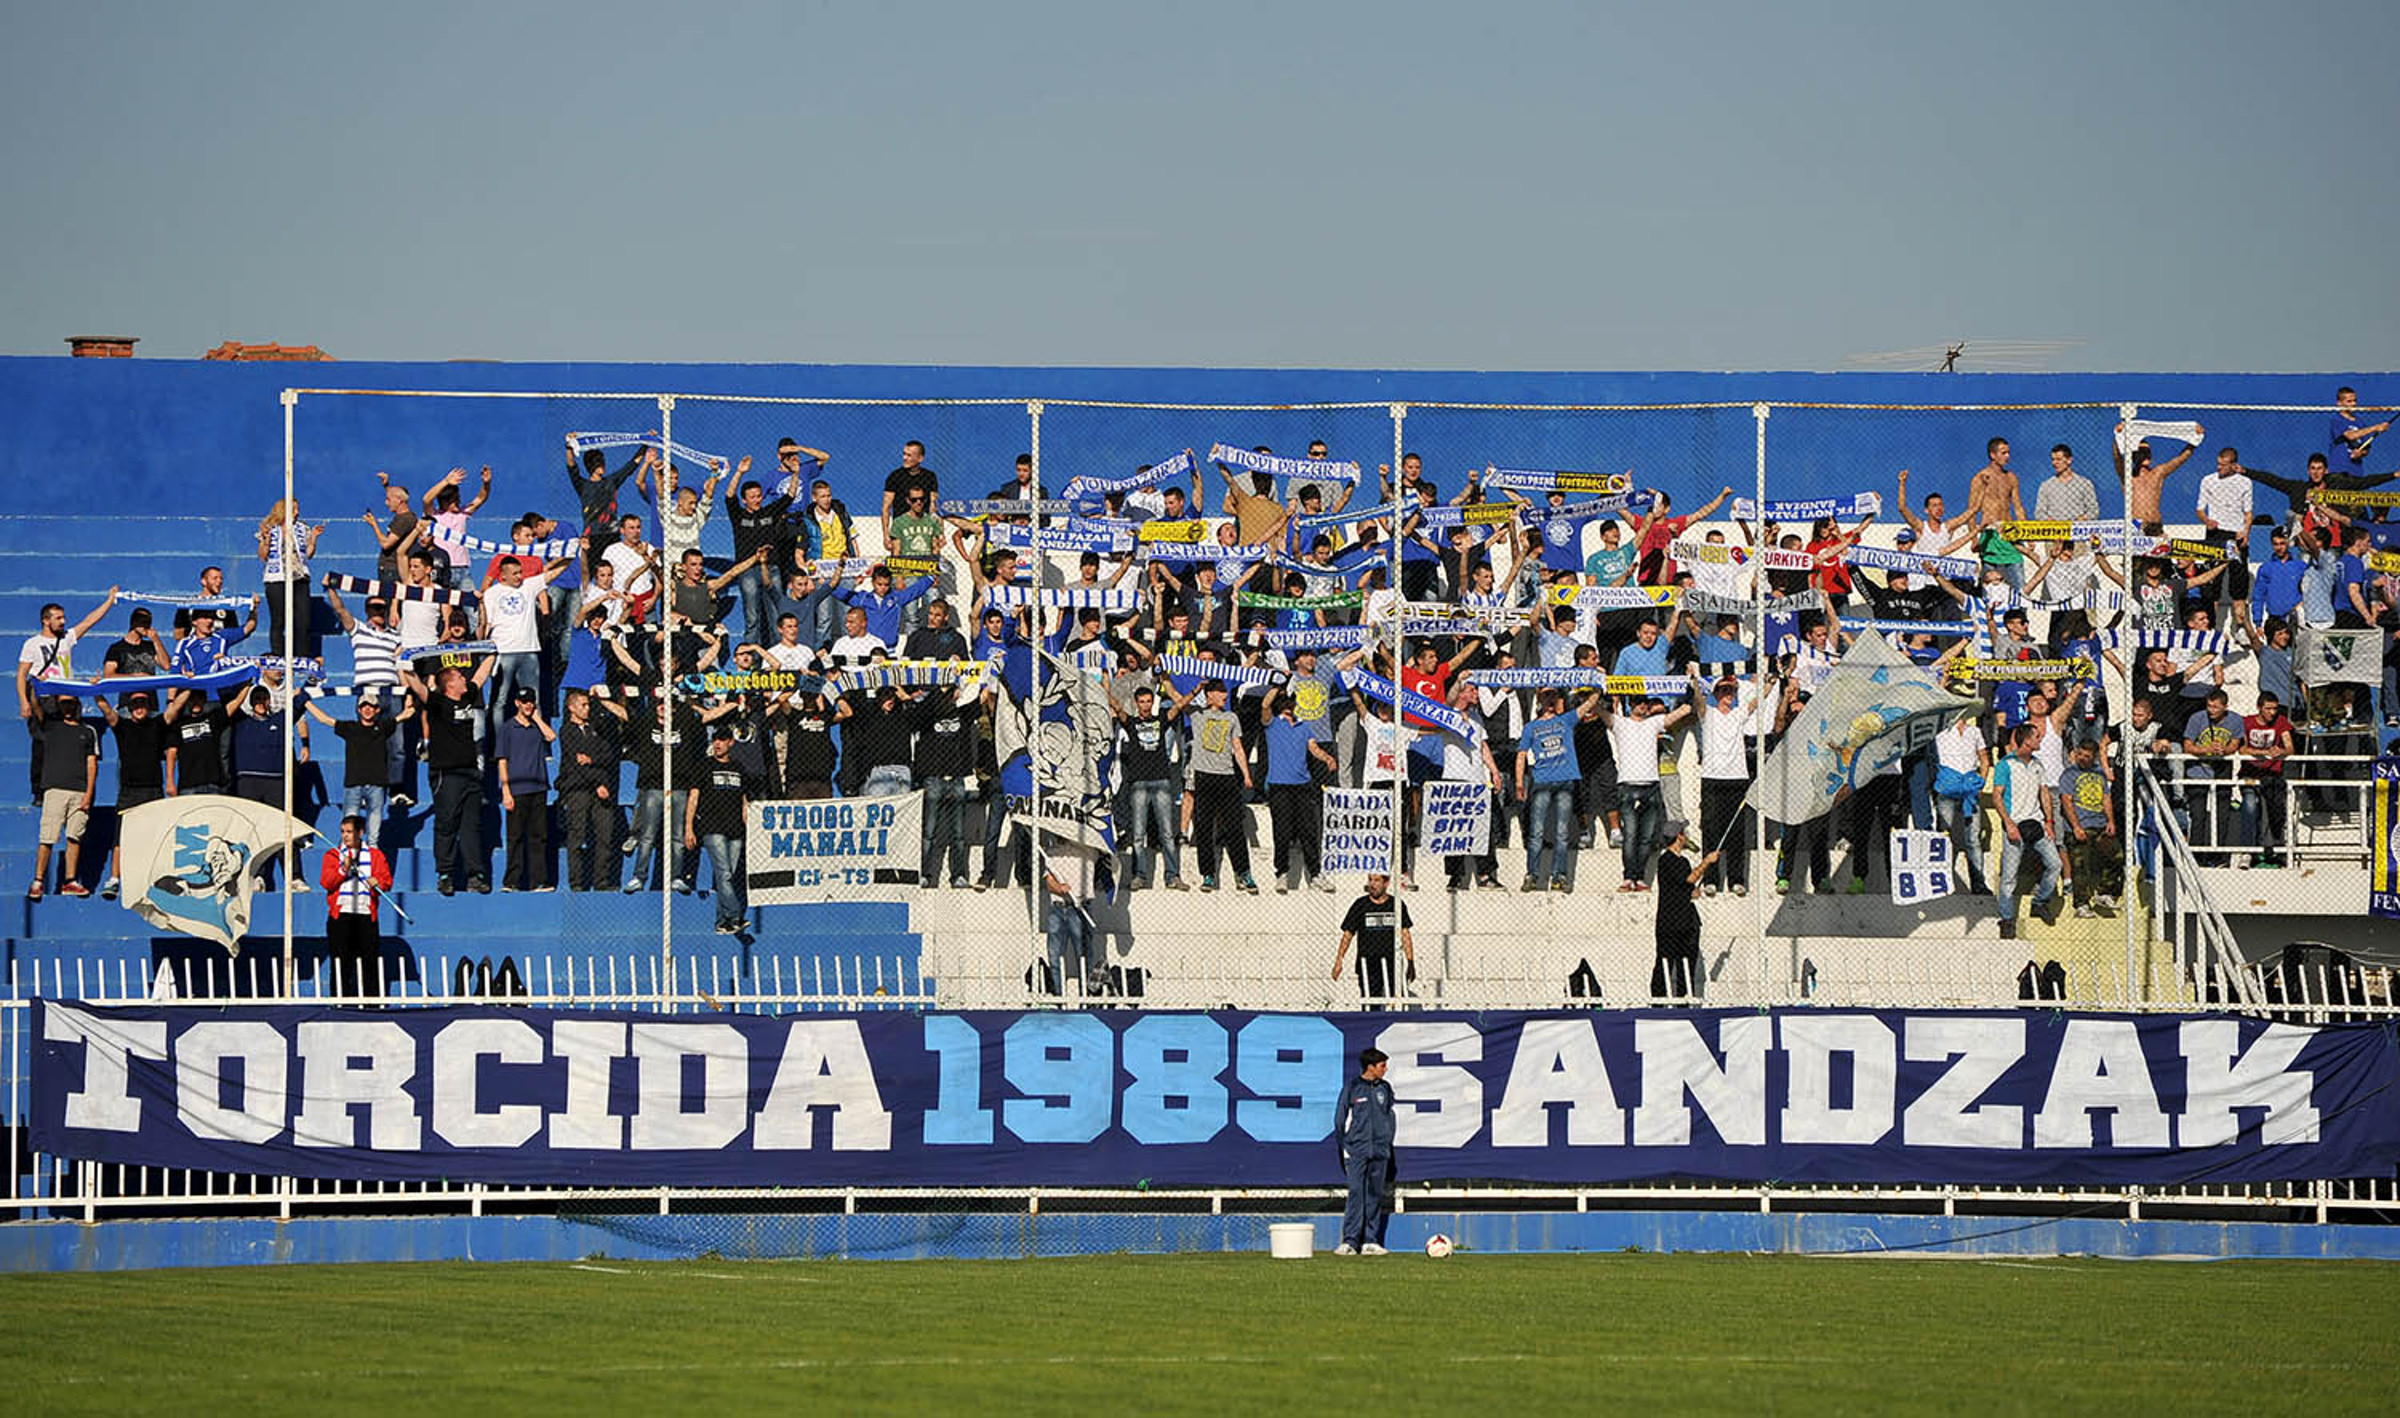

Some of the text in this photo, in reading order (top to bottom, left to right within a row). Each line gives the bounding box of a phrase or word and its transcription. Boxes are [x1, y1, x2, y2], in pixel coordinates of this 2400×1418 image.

[1763, 510, 1798, 520] PAZA
[1012, 526, 1030, 537] FK
[1068, 531, 1111, 542] PAZAR
[1036, 541, 1093, 551] ANDZAK
[1764, 551, 1810, 568] URKIYE
[1906, 554, 1958, 574] PAAR
[1327, 793, 1391, 810] MLADA
[1326, 813, 1391, 830] GARDA
[1434, 818, 1475, 834] BITI
[1325, 834, 1389, 852] PONOS
[1430, 836, 1474, 854] SAM!
[1324, 855, 1388, 872] GRADA
[43, 1003, 2321, 1152] TORCIDA 1989 SANDZAK
